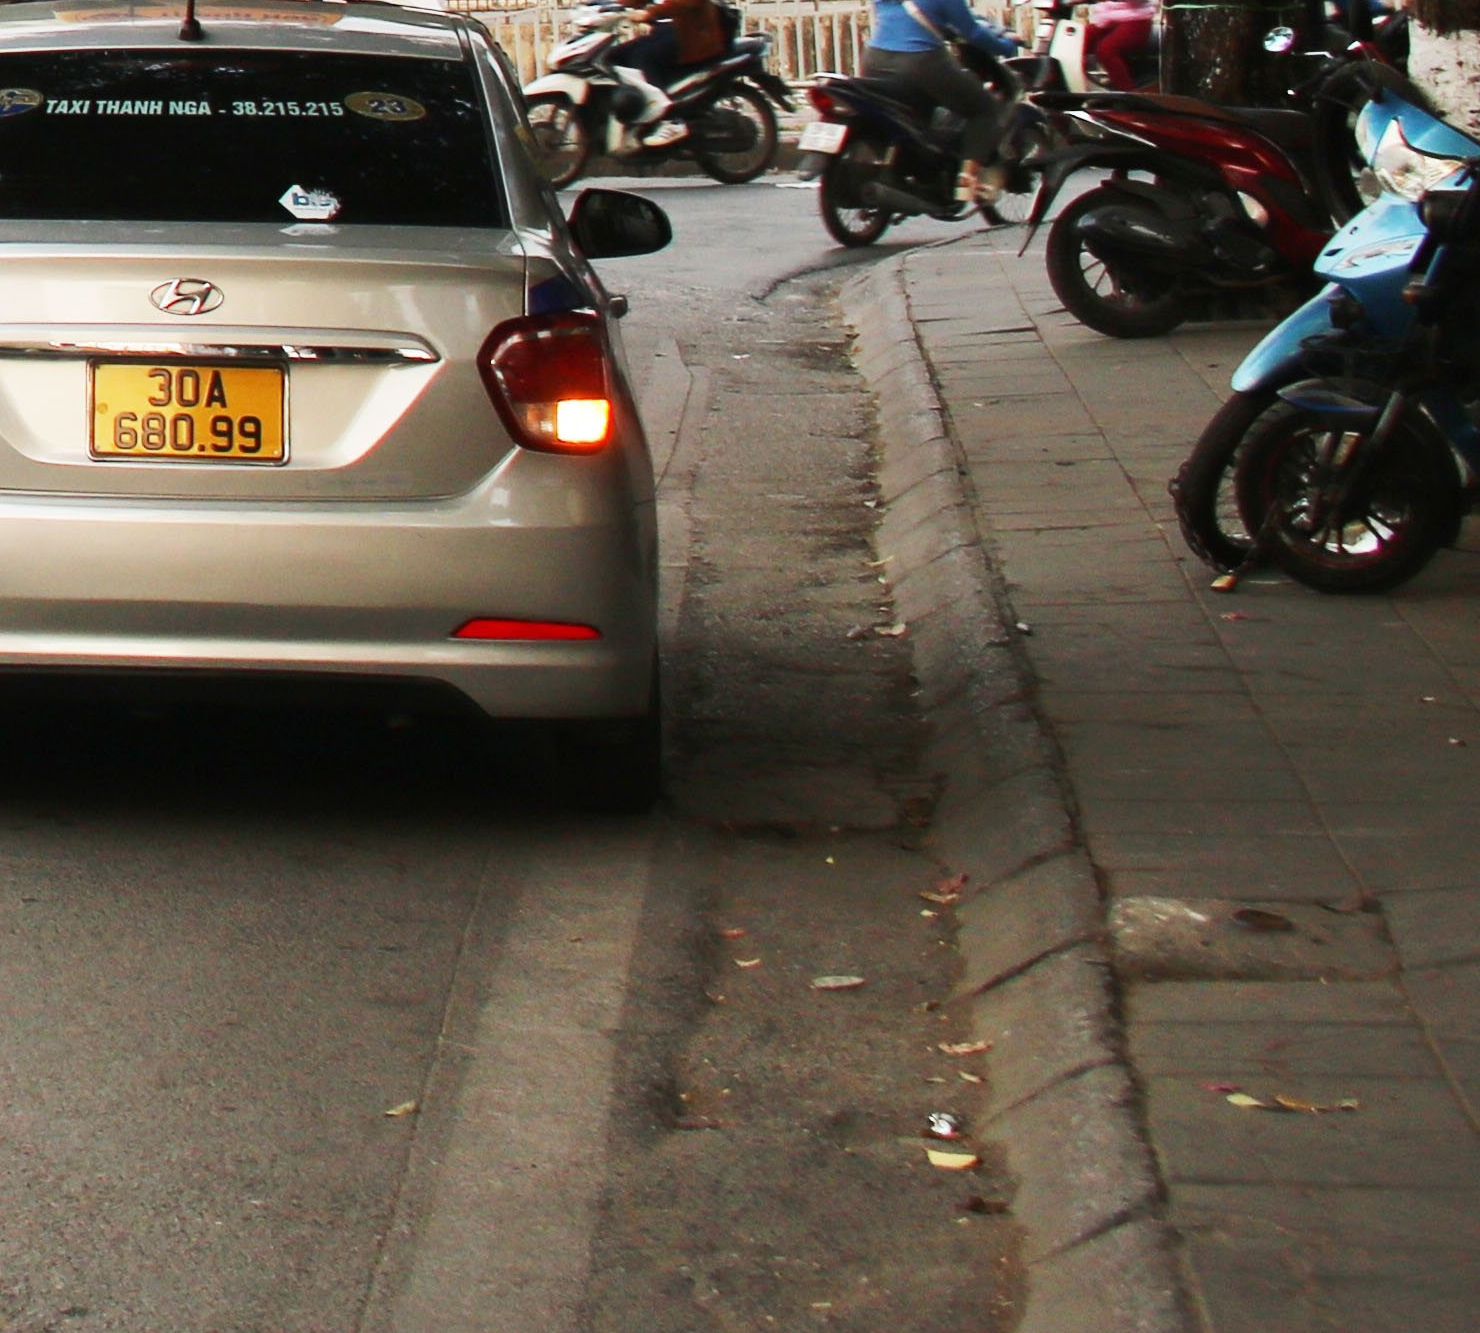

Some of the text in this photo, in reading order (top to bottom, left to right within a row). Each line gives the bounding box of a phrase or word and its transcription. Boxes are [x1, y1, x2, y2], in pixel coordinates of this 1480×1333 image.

[46, 99, 344, 117] TAXI THANH NGA 38.215.215
[147, 367, 228, 408] 30A
[113, 411, 262, 454] 680.99
